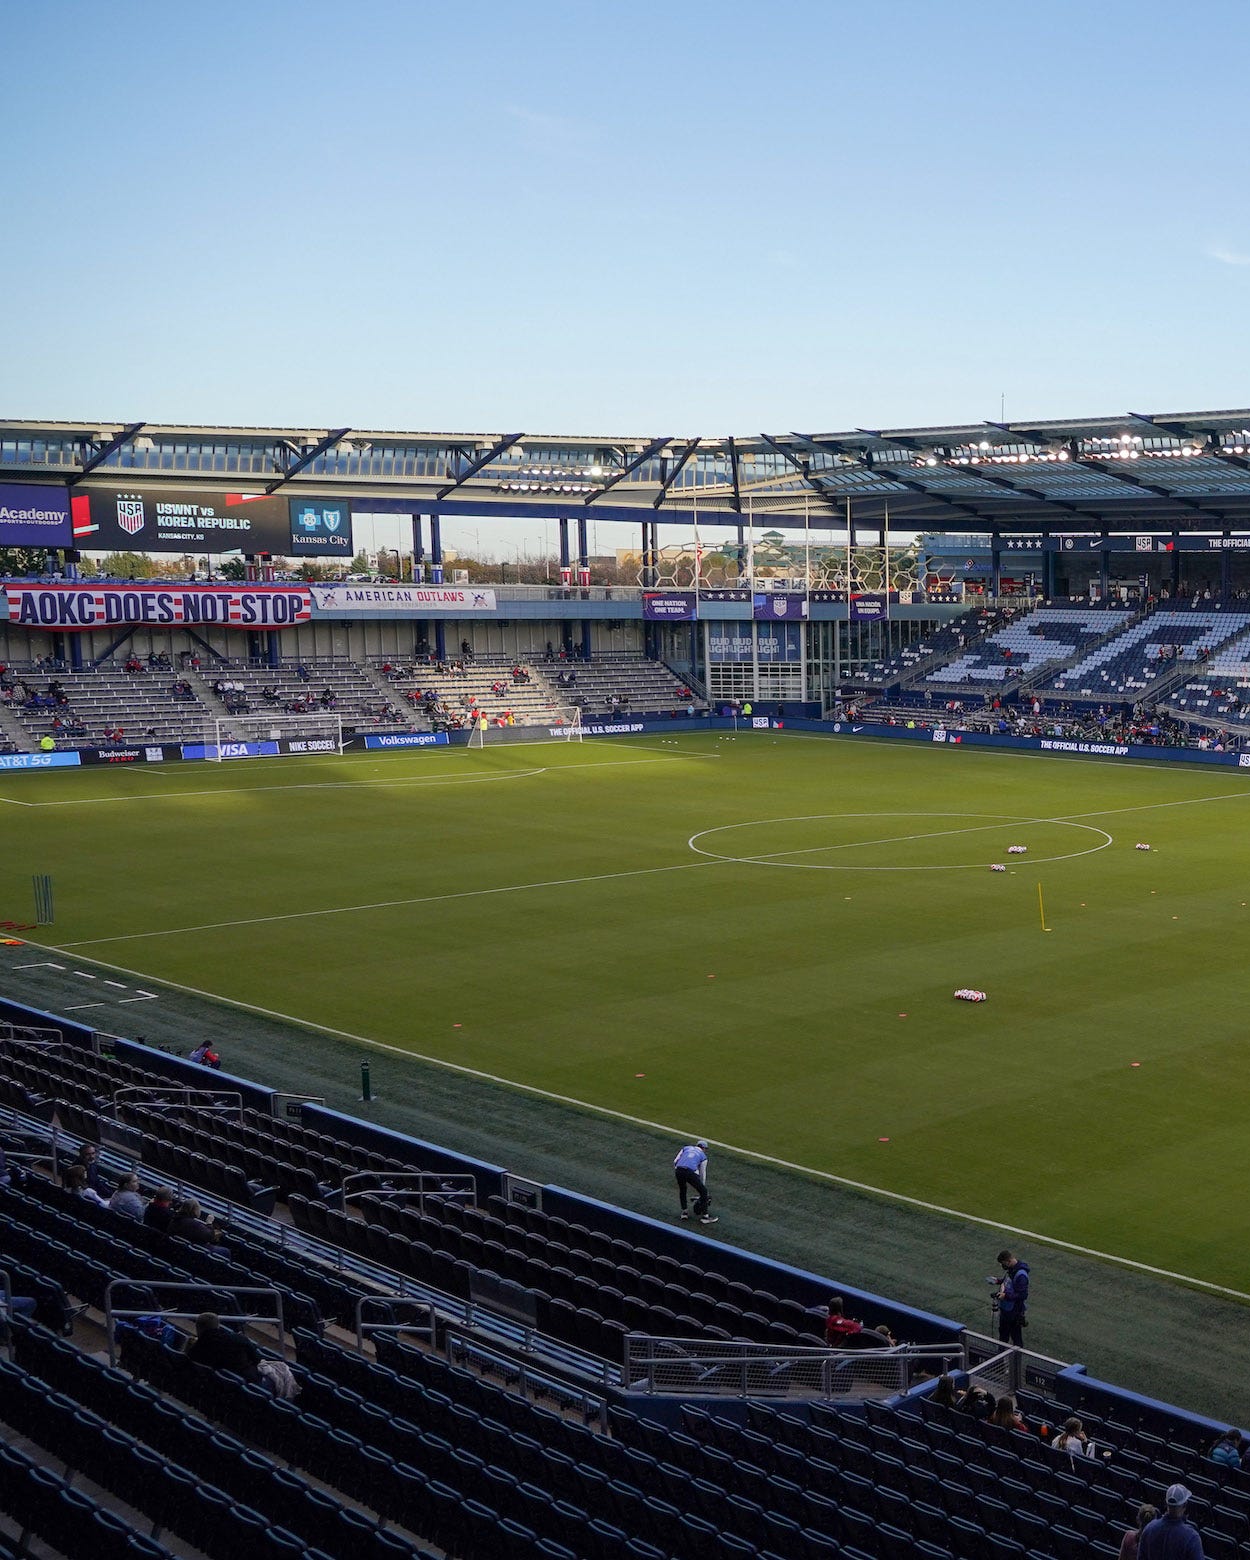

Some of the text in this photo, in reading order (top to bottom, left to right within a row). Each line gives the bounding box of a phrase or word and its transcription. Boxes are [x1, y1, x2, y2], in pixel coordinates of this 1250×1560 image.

[0, 507, 66, 523] Academy
[156, 503, 199, 515] USWNT
[157, 516, 251, 530] KOREA REPUBLIC
[292, 534, 349, 546] Kansas City
[1208, 539, 1222, 547] THE
[346, 591, 465, 602] AMERICAN OUTLAWS
[19, 592, 303, 624] AOKC DOES NOT STOP
[710, 638, 730, 646] BUD
[732, 638, 752, 646] BUD
[758, 638, 778, 646] BUD
[549, 724, 643, 736] THE OFFICIAL U.S. SOCCER APP
[289, 739, 336, 752] NIKE SOCCER
[378, 735, 437, 745] Volkswagen
[214, 743, 249, 756] VISA
[1040, 740, 1128, 755] THE OFFICIAL U.S. SOCCER APP
[98, 750, 140, 759] Budweiser
[0, 755, 52, 767] AT&T 5G
